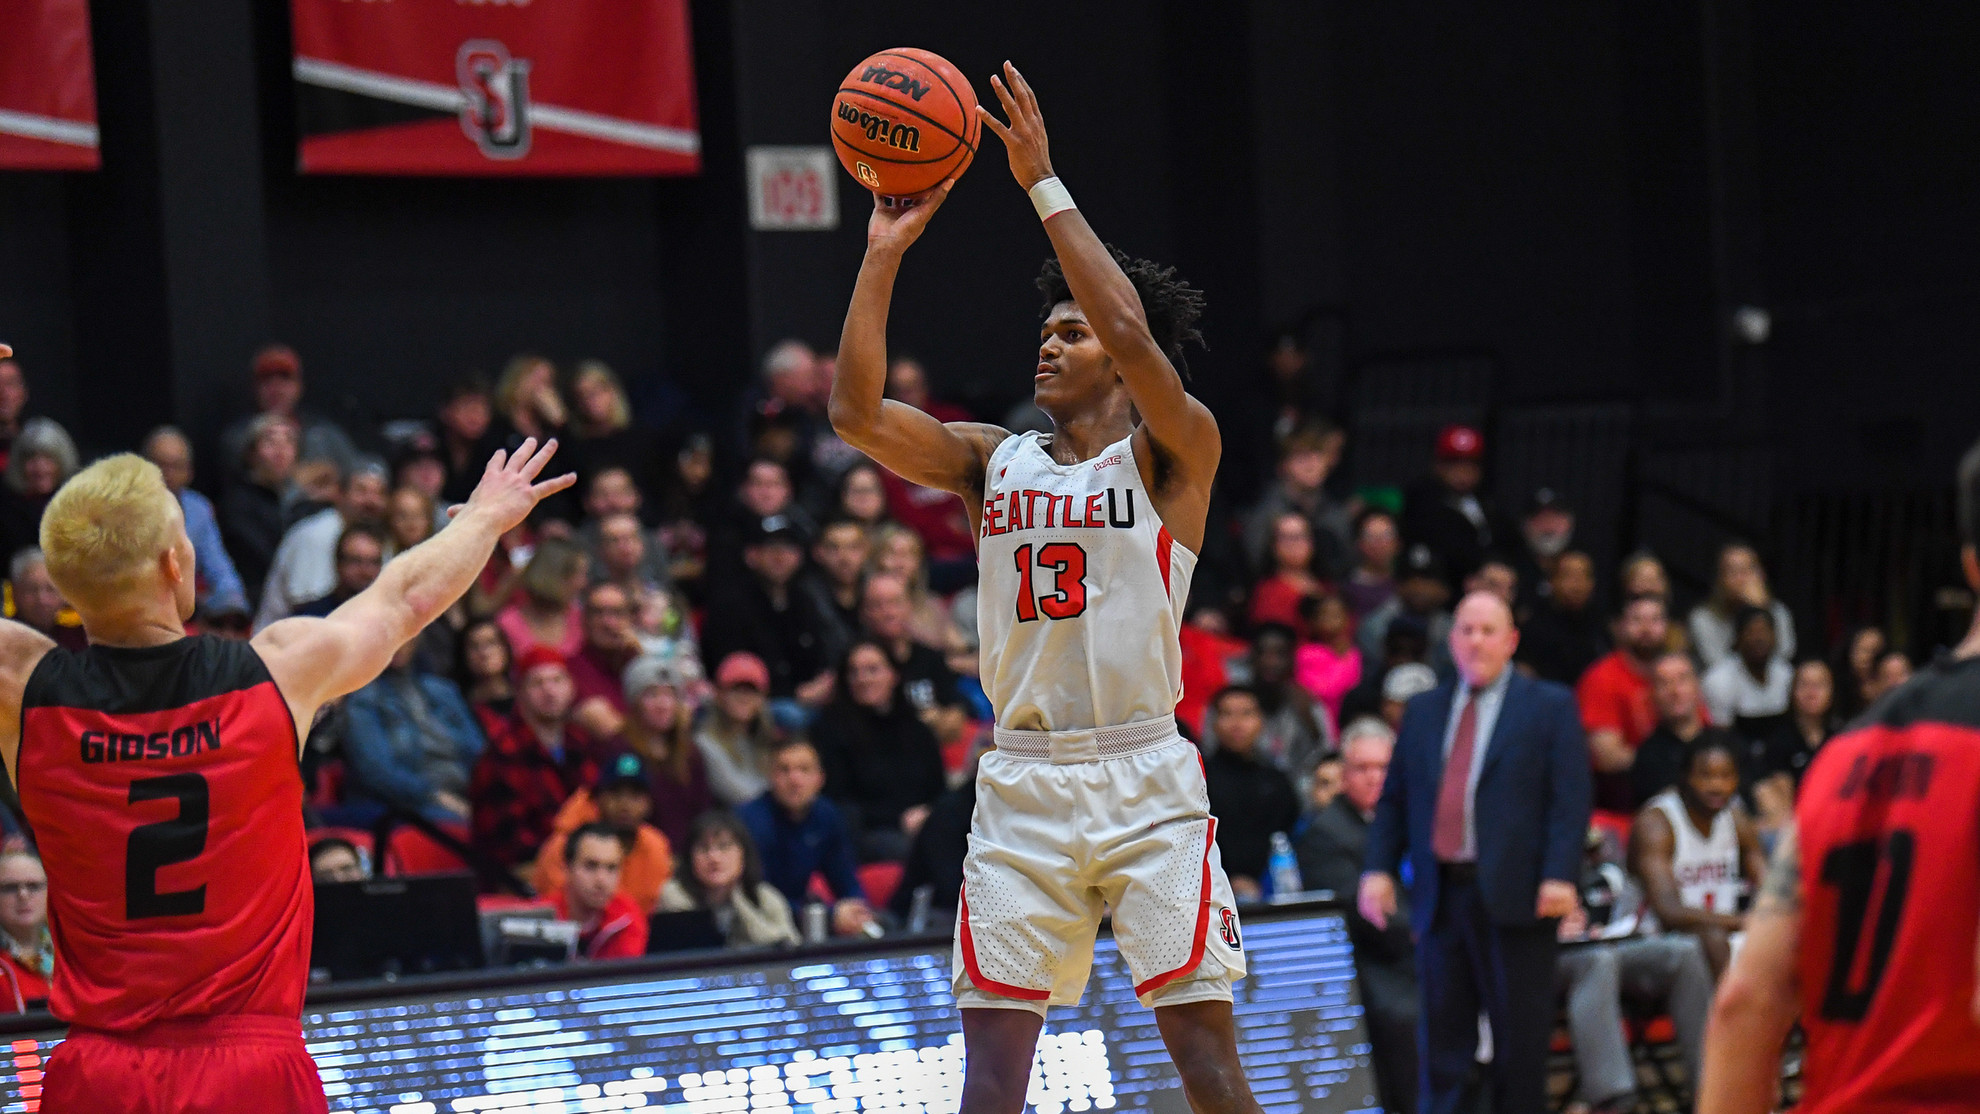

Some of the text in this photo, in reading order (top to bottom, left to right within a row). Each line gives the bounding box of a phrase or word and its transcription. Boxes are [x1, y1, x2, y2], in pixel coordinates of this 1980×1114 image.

[860, 65, 930, 102] NCAA
[837, 100, 920, 153] Wilson
[1093, 455, 1122, 471] WAC
[1014, 542, 1087, 623] 13
[125, 772, 209, 920] 2
